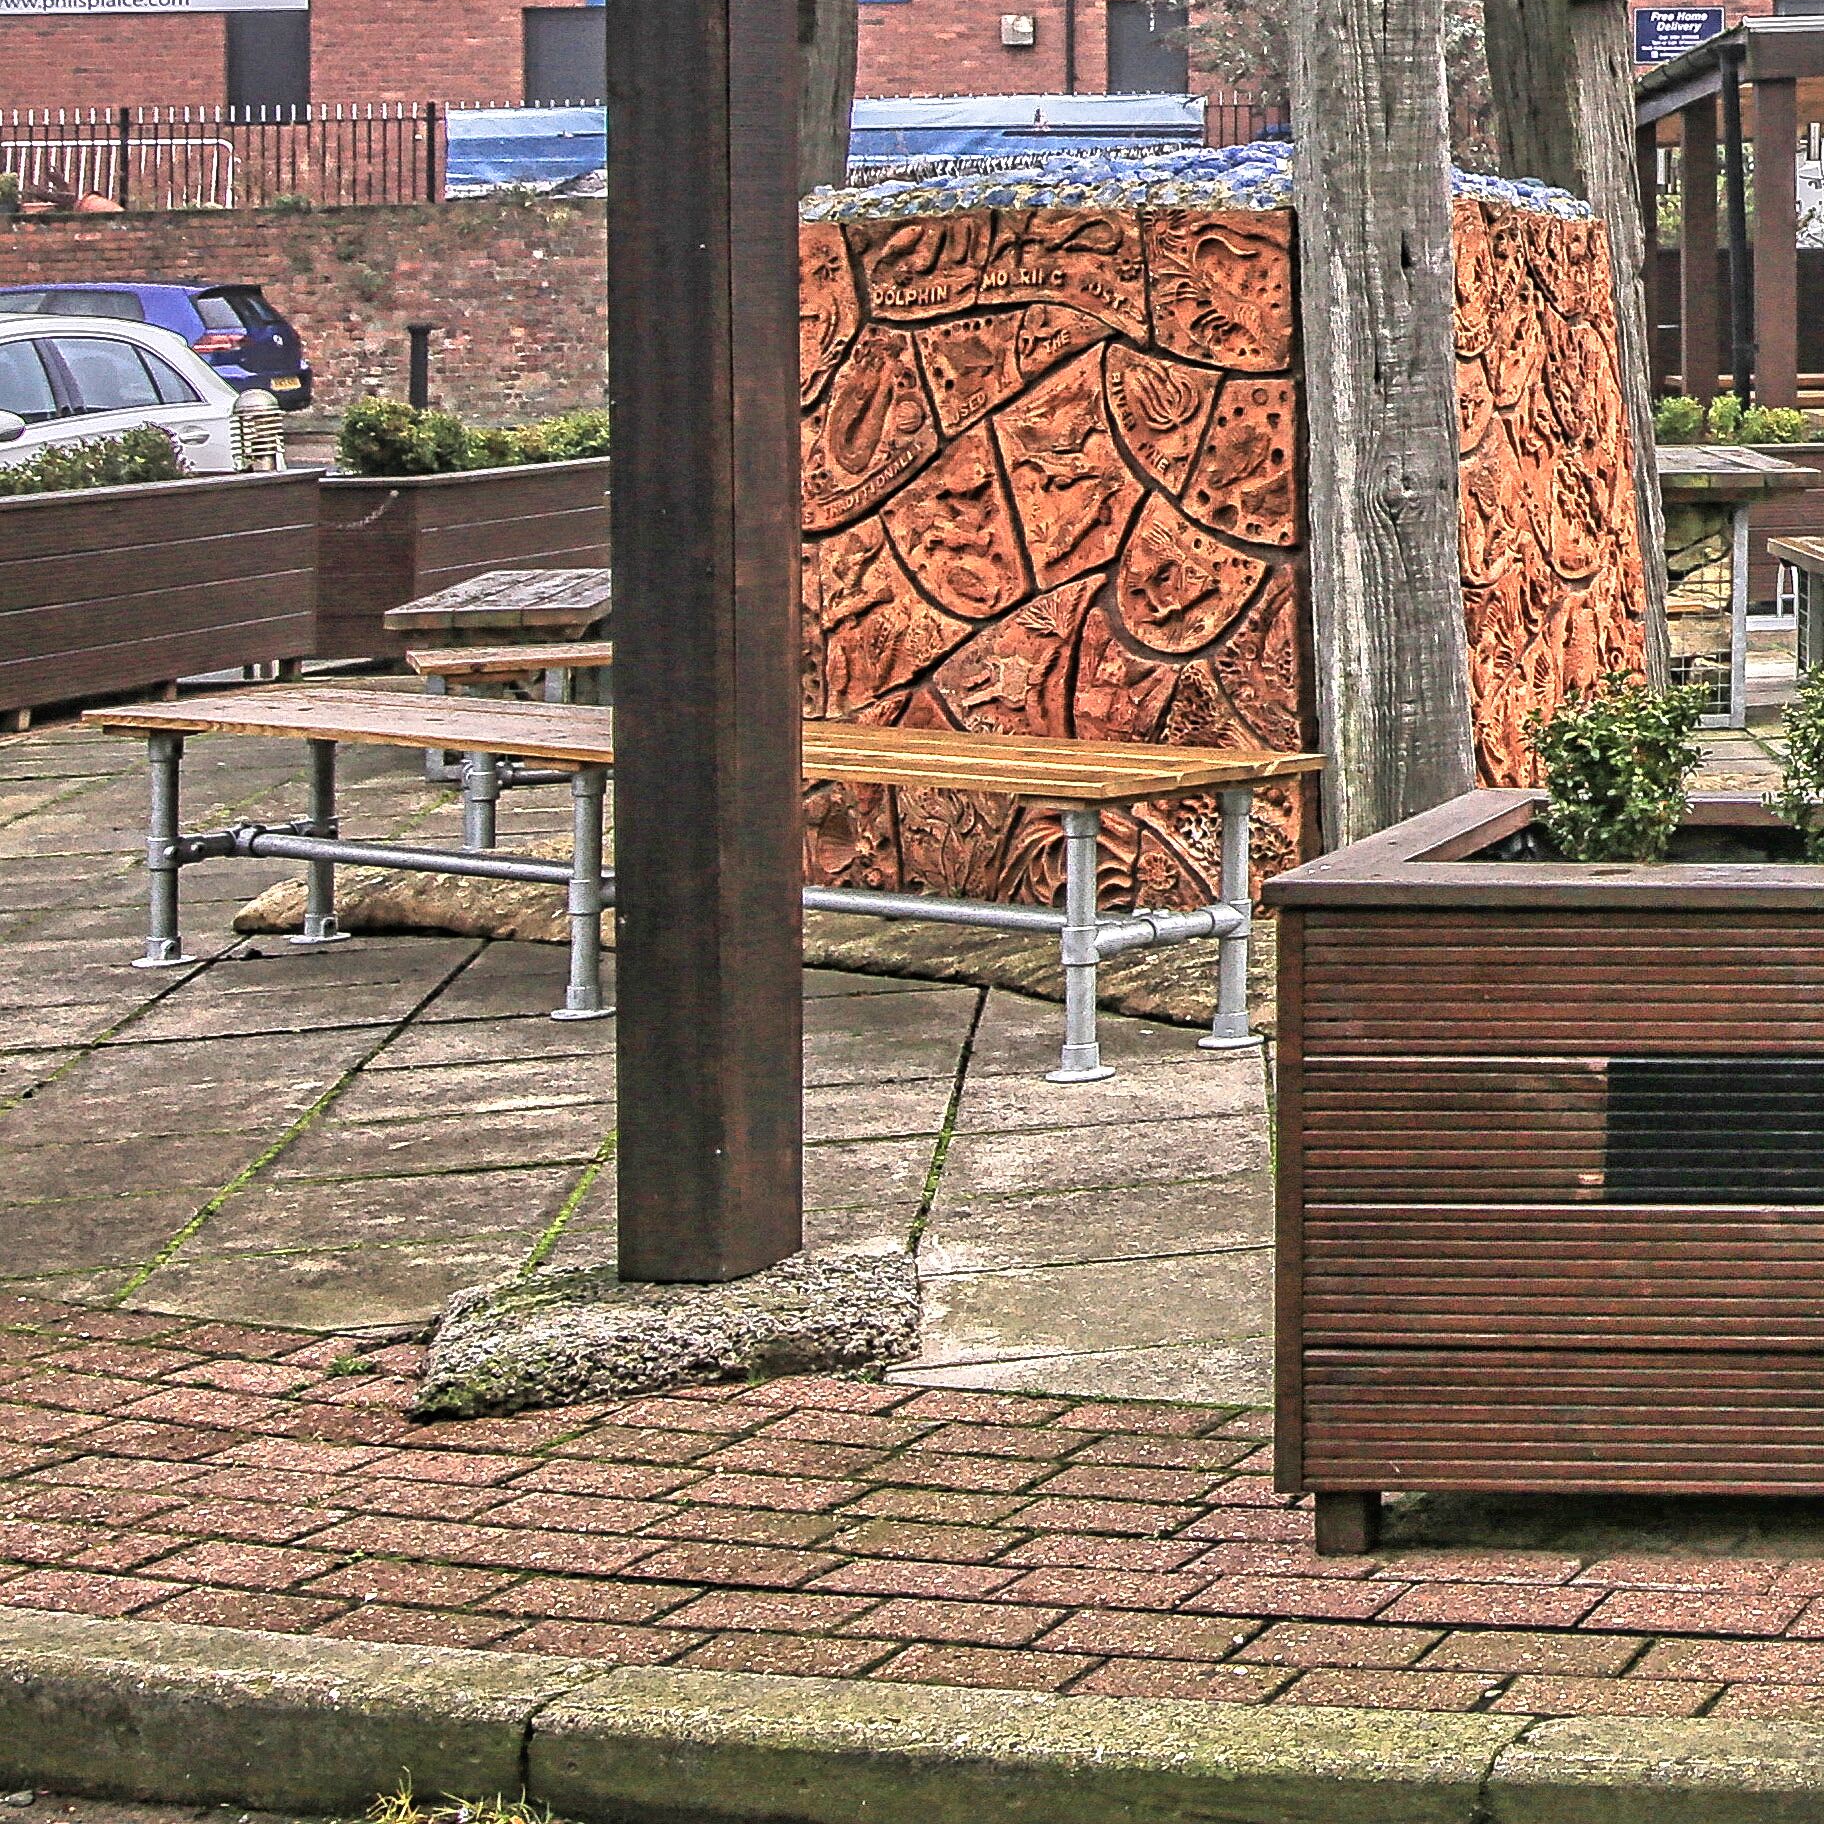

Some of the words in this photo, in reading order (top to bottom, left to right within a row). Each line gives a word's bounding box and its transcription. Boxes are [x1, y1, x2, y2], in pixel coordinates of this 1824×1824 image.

[1650, 11, 1675, 22] Free
[1676, 11, 1708, 21] Home
[1656, 21, 1703, 33] Delivery
[872, 284, 949, 306] DOLPHIN
